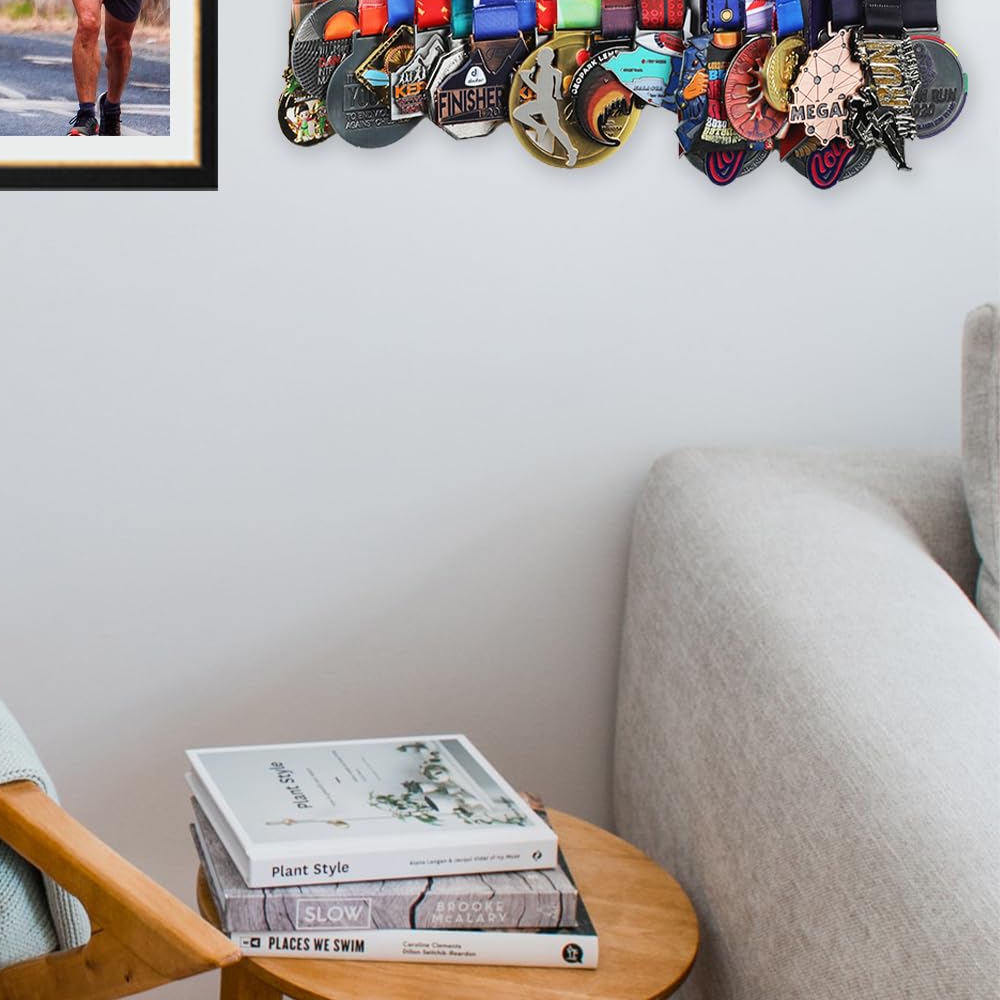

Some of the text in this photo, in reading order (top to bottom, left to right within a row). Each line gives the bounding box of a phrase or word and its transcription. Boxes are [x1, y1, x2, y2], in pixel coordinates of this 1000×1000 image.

[440, 86, 504, 118] FINISHER
[271, 861, 350, 878] Plant Style
[304, 906, 364, 922] SLOW
[436, 900, 505, 912] BROOKE
[268, 936, 365, 953] PLACES WE SWIM
[402, 941, 430, 949] Caroline
